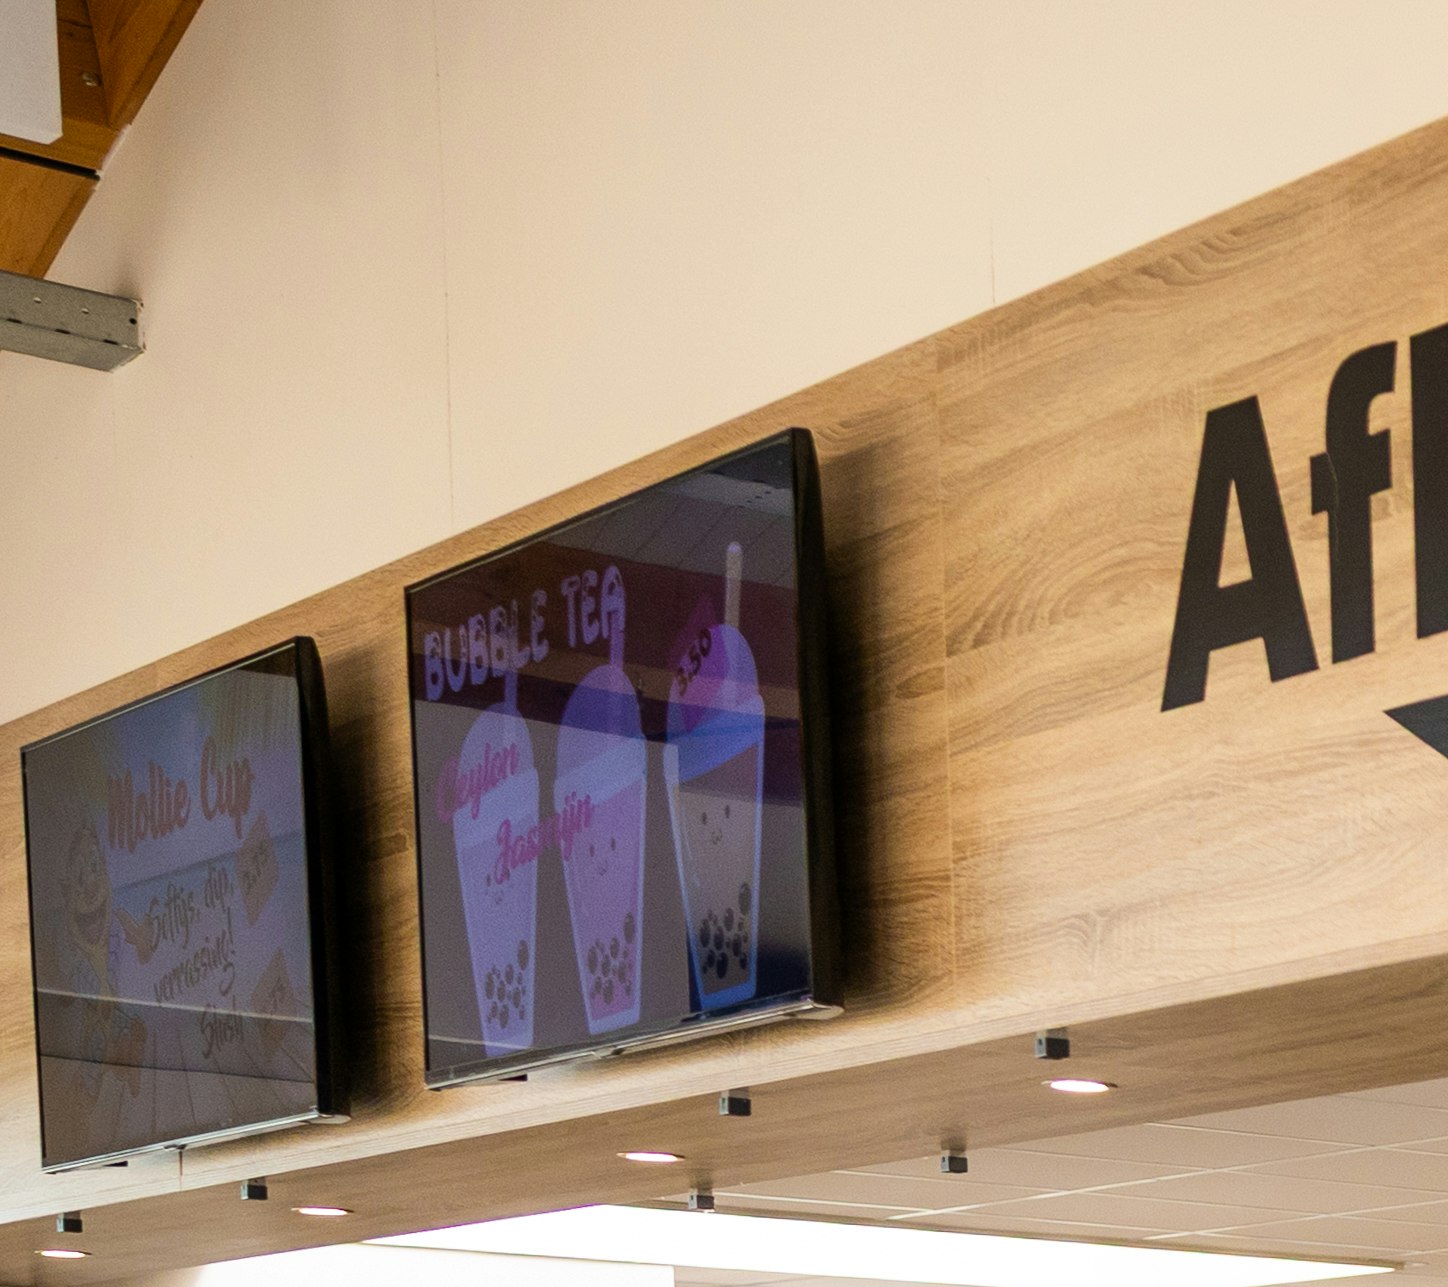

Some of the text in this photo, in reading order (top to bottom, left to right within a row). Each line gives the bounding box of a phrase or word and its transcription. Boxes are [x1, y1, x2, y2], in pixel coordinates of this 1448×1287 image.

[424, 564, 627, 702] BUBBLE TEA
[106, 736, 257, 855] Mollie Cup
